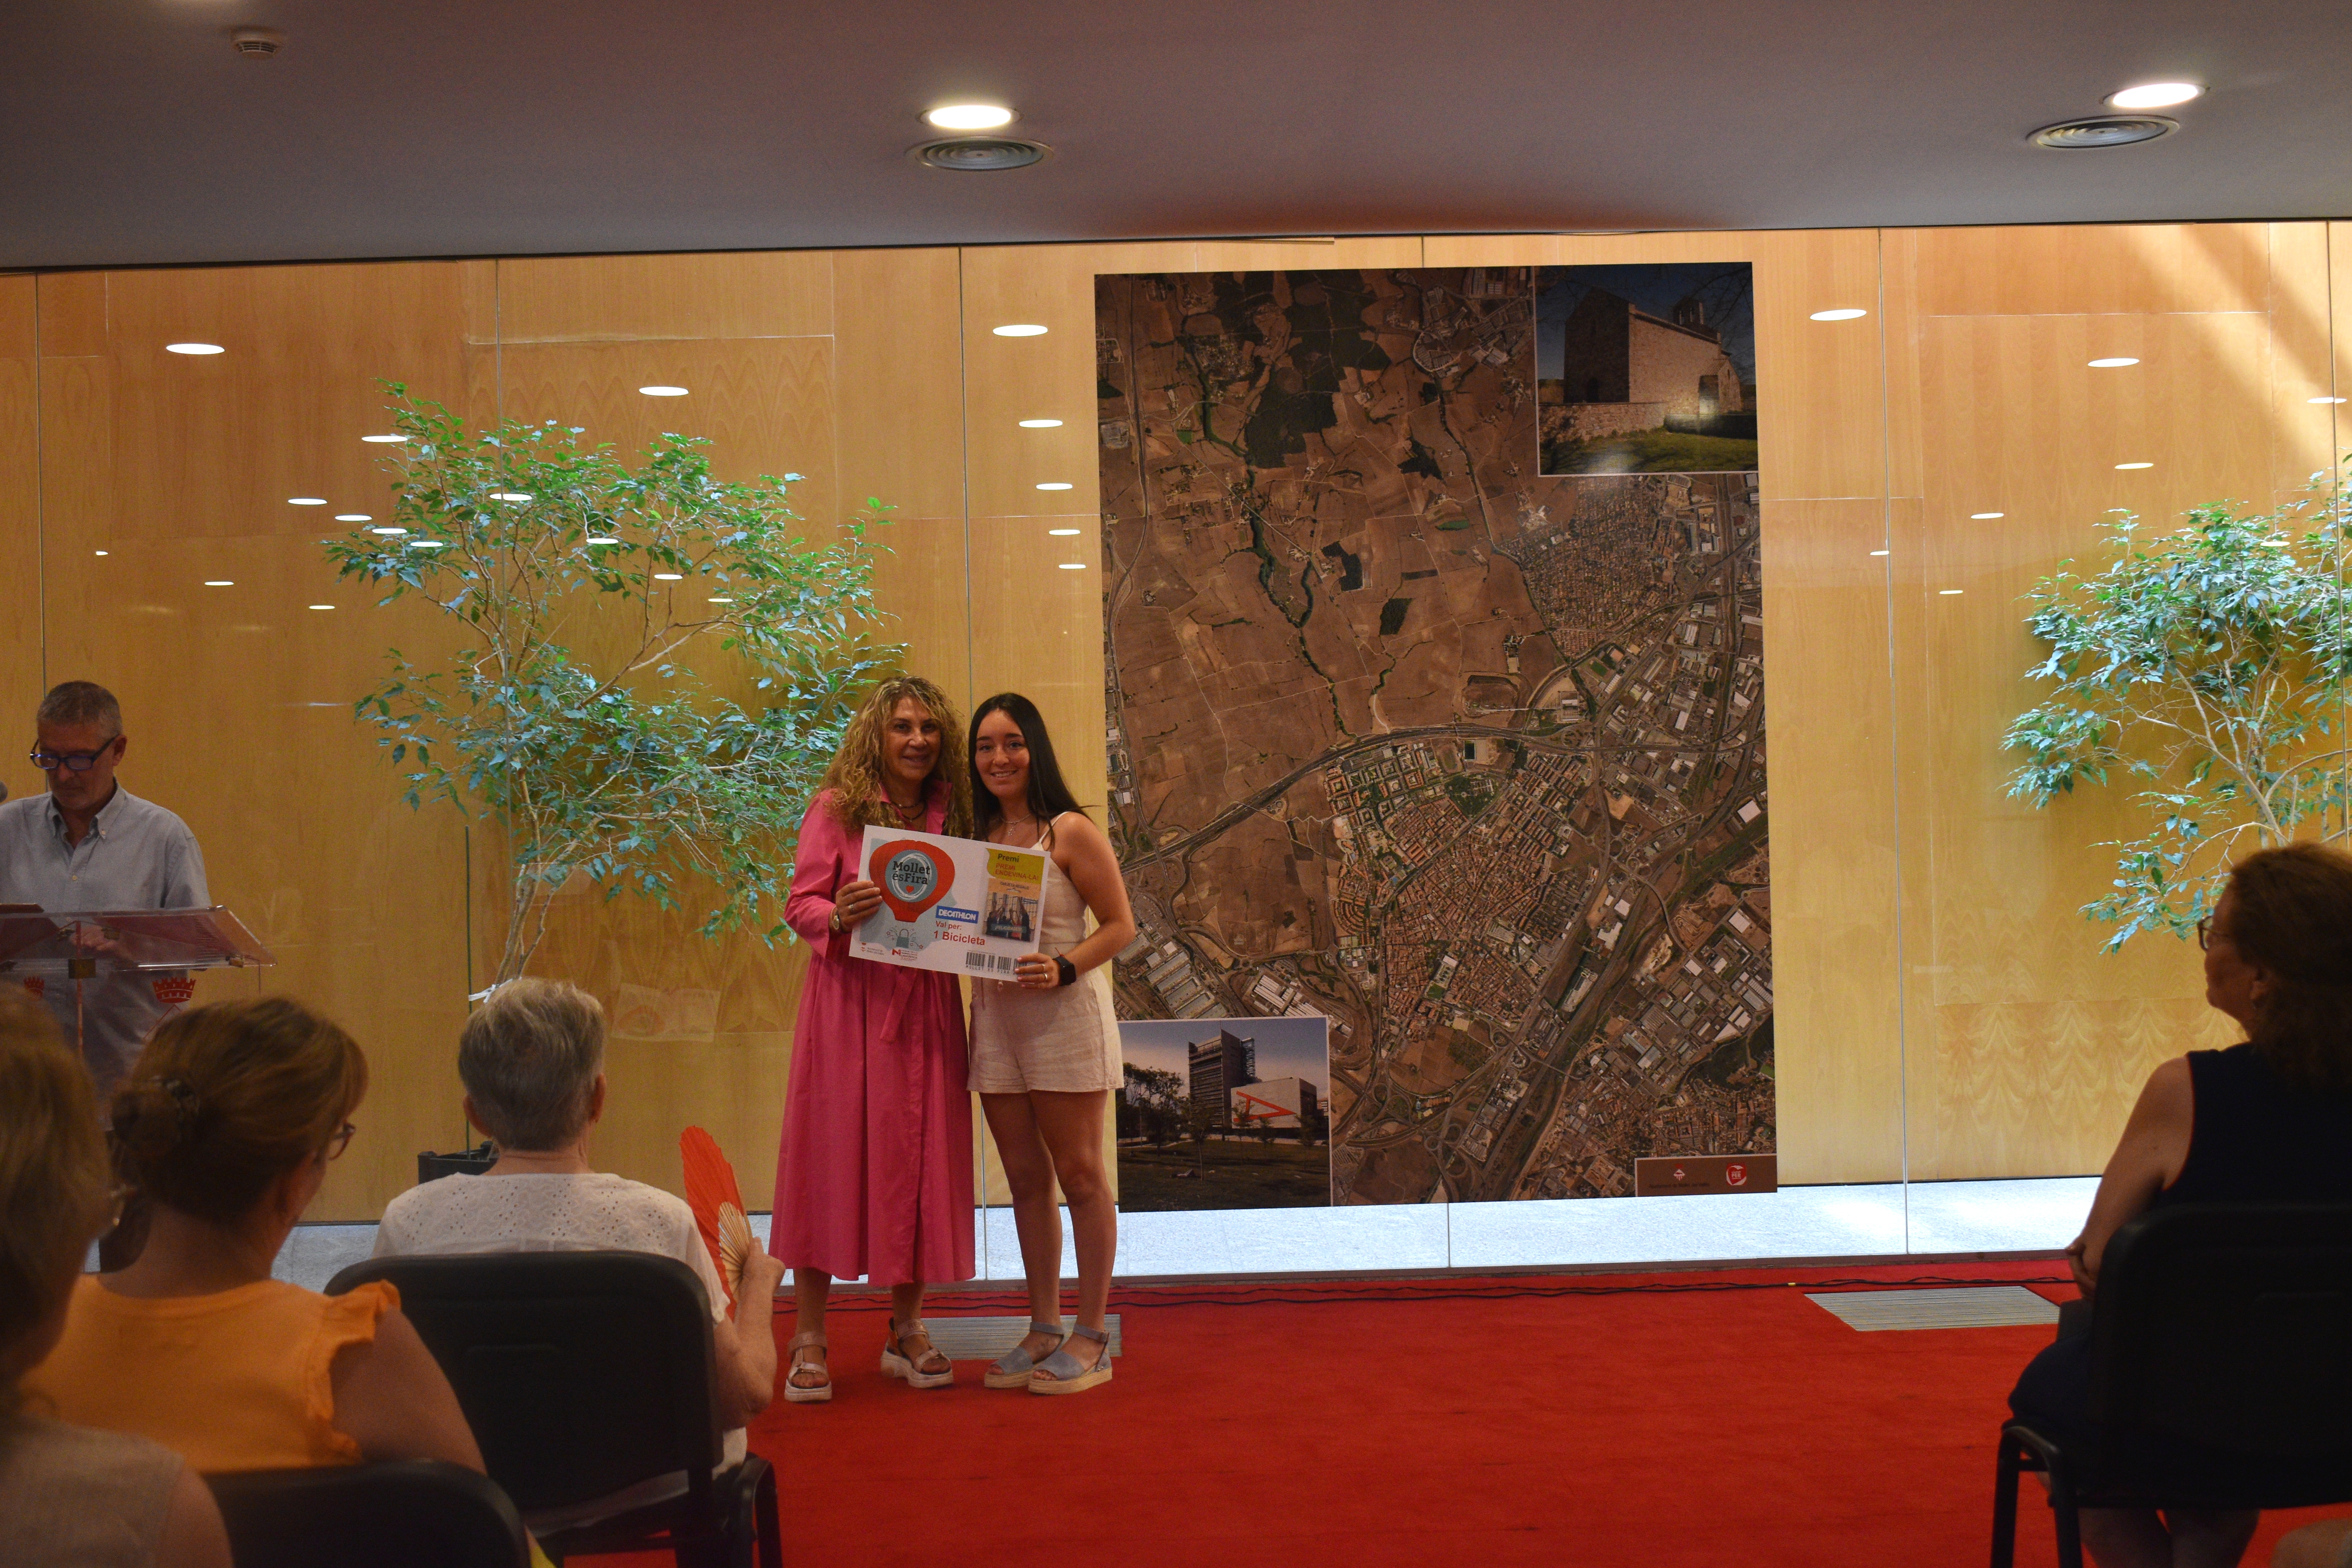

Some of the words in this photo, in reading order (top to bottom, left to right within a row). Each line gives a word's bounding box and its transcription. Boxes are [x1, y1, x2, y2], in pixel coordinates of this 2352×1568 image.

[998, 853, 1019, 862] Premi
[893, 861, 930, 875] Mollet
[938, 909, 976, 920] DECATHLON
[934, 930, 938, 938] 1
[942, 931, 985, 945] Bicicleta
